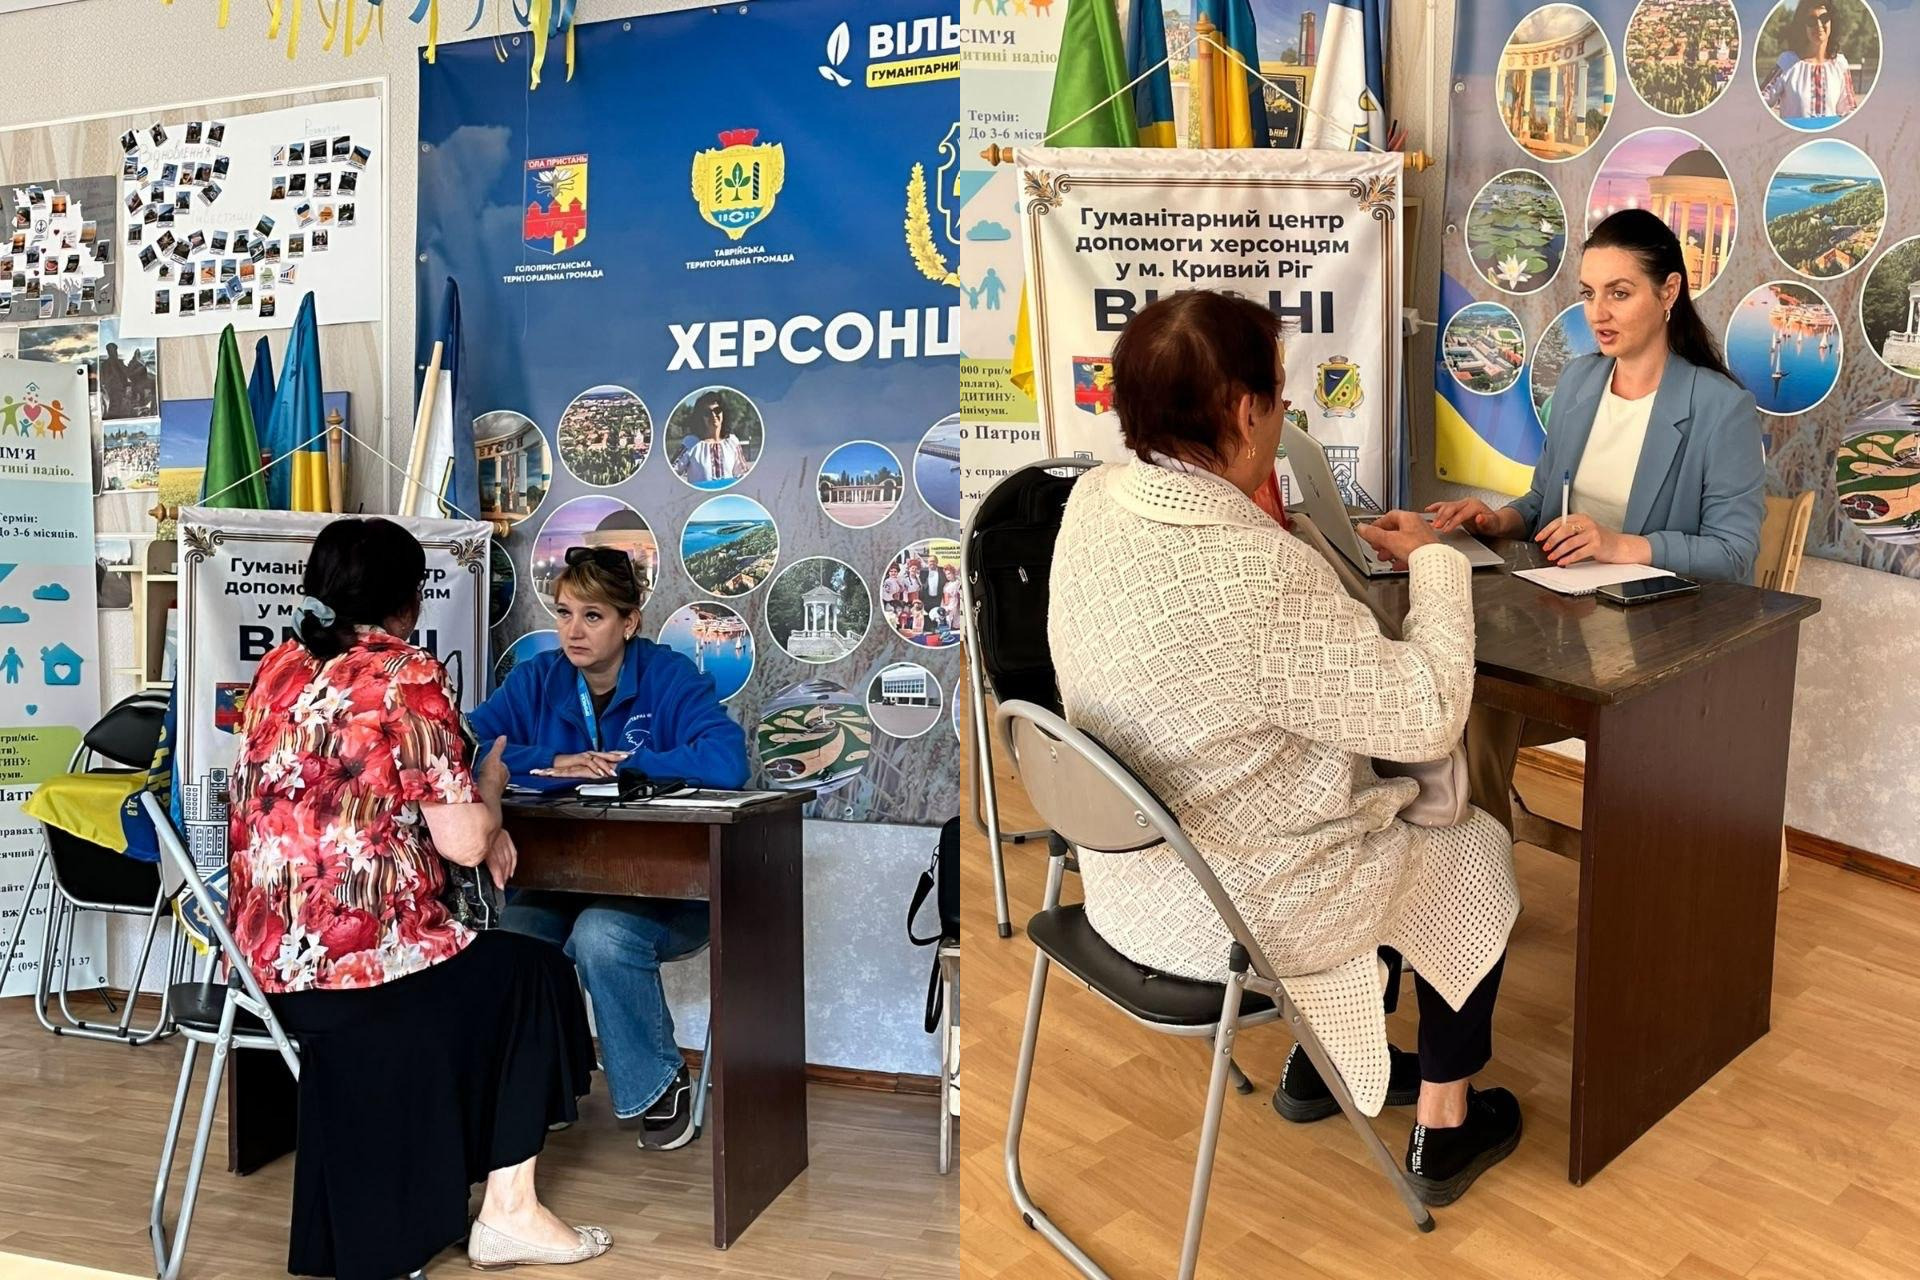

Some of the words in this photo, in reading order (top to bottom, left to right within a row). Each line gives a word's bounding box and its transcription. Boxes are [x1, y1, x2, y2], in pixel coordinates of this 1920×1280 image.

[869, 15, 960, 59] ВІЛЬ
[960, 28, 1015, 45] СІМ'Я
[960, 48, 1007, 62] итині
[871, 61, 960, 81] ГУМАНІТАРНИ
[968, 109, 1020, 124] Термін:
[968, 127, 987, 140] До
[990, 128, 1010, 139] 3-6
[1081, 207, 1260, 231] Гуманітарний
[1268, 214, 1345, 233] центр
[714, 245, 765, 257] ТАВРІЙСЬКА
[1076, 236, 1203, 253] допомоги
[1210, 238, 1349, 257] херсонцям
[515, 260, 592, 273] ГОЛОПРИСТАНСЬКА
[685, 257, 751, 270] ТЕРИТОРІАЛЬНА
[752, 253, 795, 264] ГРОМАДА
[503, 273, 565, 284] ТЕРИТОРІАЛЬНА
[565, 269, 604, 280] ГРОМАДА
[1115, 262, 1131, 281] у
[1138, 263, 1165, 277] м.
[1172, 259, 1270, 282] Кривий
[1278, 259, 1313, 278] Ріг
[960, 391, 1016, 402] ДИТИНУ:
[975, 425, 1041, 444] Патрон
[13, 527, 30, 537] 3-6
[33, 528, 79, 539] місяців.
[257, 604, 272, 619] у
[2, 909, 20, 918] вж
